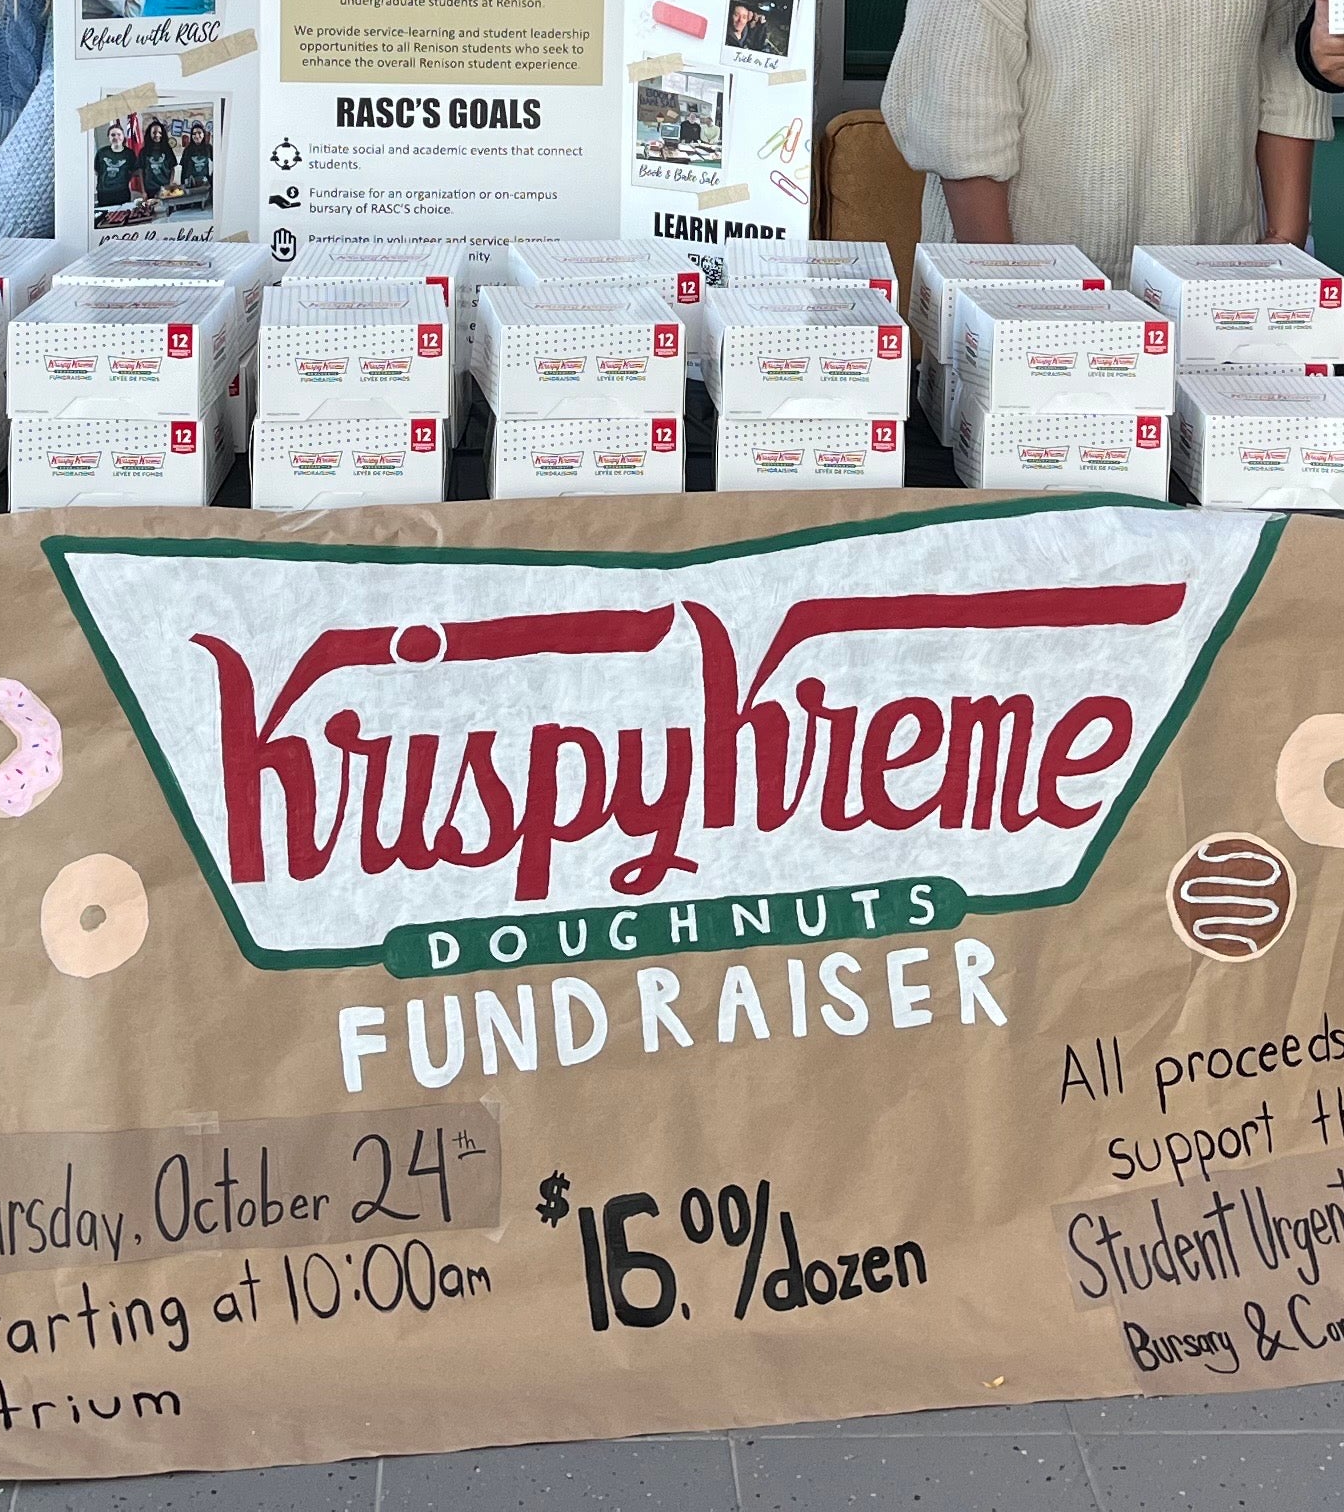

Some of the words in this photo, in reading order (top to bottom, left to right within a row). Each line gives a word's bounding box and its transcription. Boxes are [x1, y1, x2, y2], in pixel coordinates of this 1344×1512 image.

[80, 24, 132, 51] Refuel
[136, 18, 171, 45] with
[175, 20, 221, 45] RASC
[300, 41, 378, 53] opportunities
[462, 43, 511, 53] students
[543, 44, 568, 54] seek
[337, 97, 440, 128] RASC'S
[449, 98, 540, 129] GOALS
[309, 144, 349, 154] Initiate
[353, 144, 384, 154] social
[413, 145, 467, 155] academic
[471, 147, 507, 155] events
[639, 165, 662, 178] Book
[674, 168, 697, 182] Bake
[700, 173, 720, 185] Sale
[654, 212, 718, 244] LEARN
[1324, 287, 1338, 300] 12
[422, 333, 438, 347] 12
[882, 336, 898, 349] 12
[188, 602, 698, 900] Krispy
[680, 582, 1188, 841] Kreme
[427, 880, 940, 971] DOUGHNUTS
[338, 938, 1008, 1091] FUNDRAISER
[1061, 1037, 1124, 1104] All
[1108, 1101, 1273, 1186] support
[155, 1146, 330, 1243] October
[1068, 1191, 1240, 1299] Student
[214, 1259, 260, 1323] at
[1123, 1321, 1240, 1373] Bursary
[1244, 1301, 1299, 1360] &
